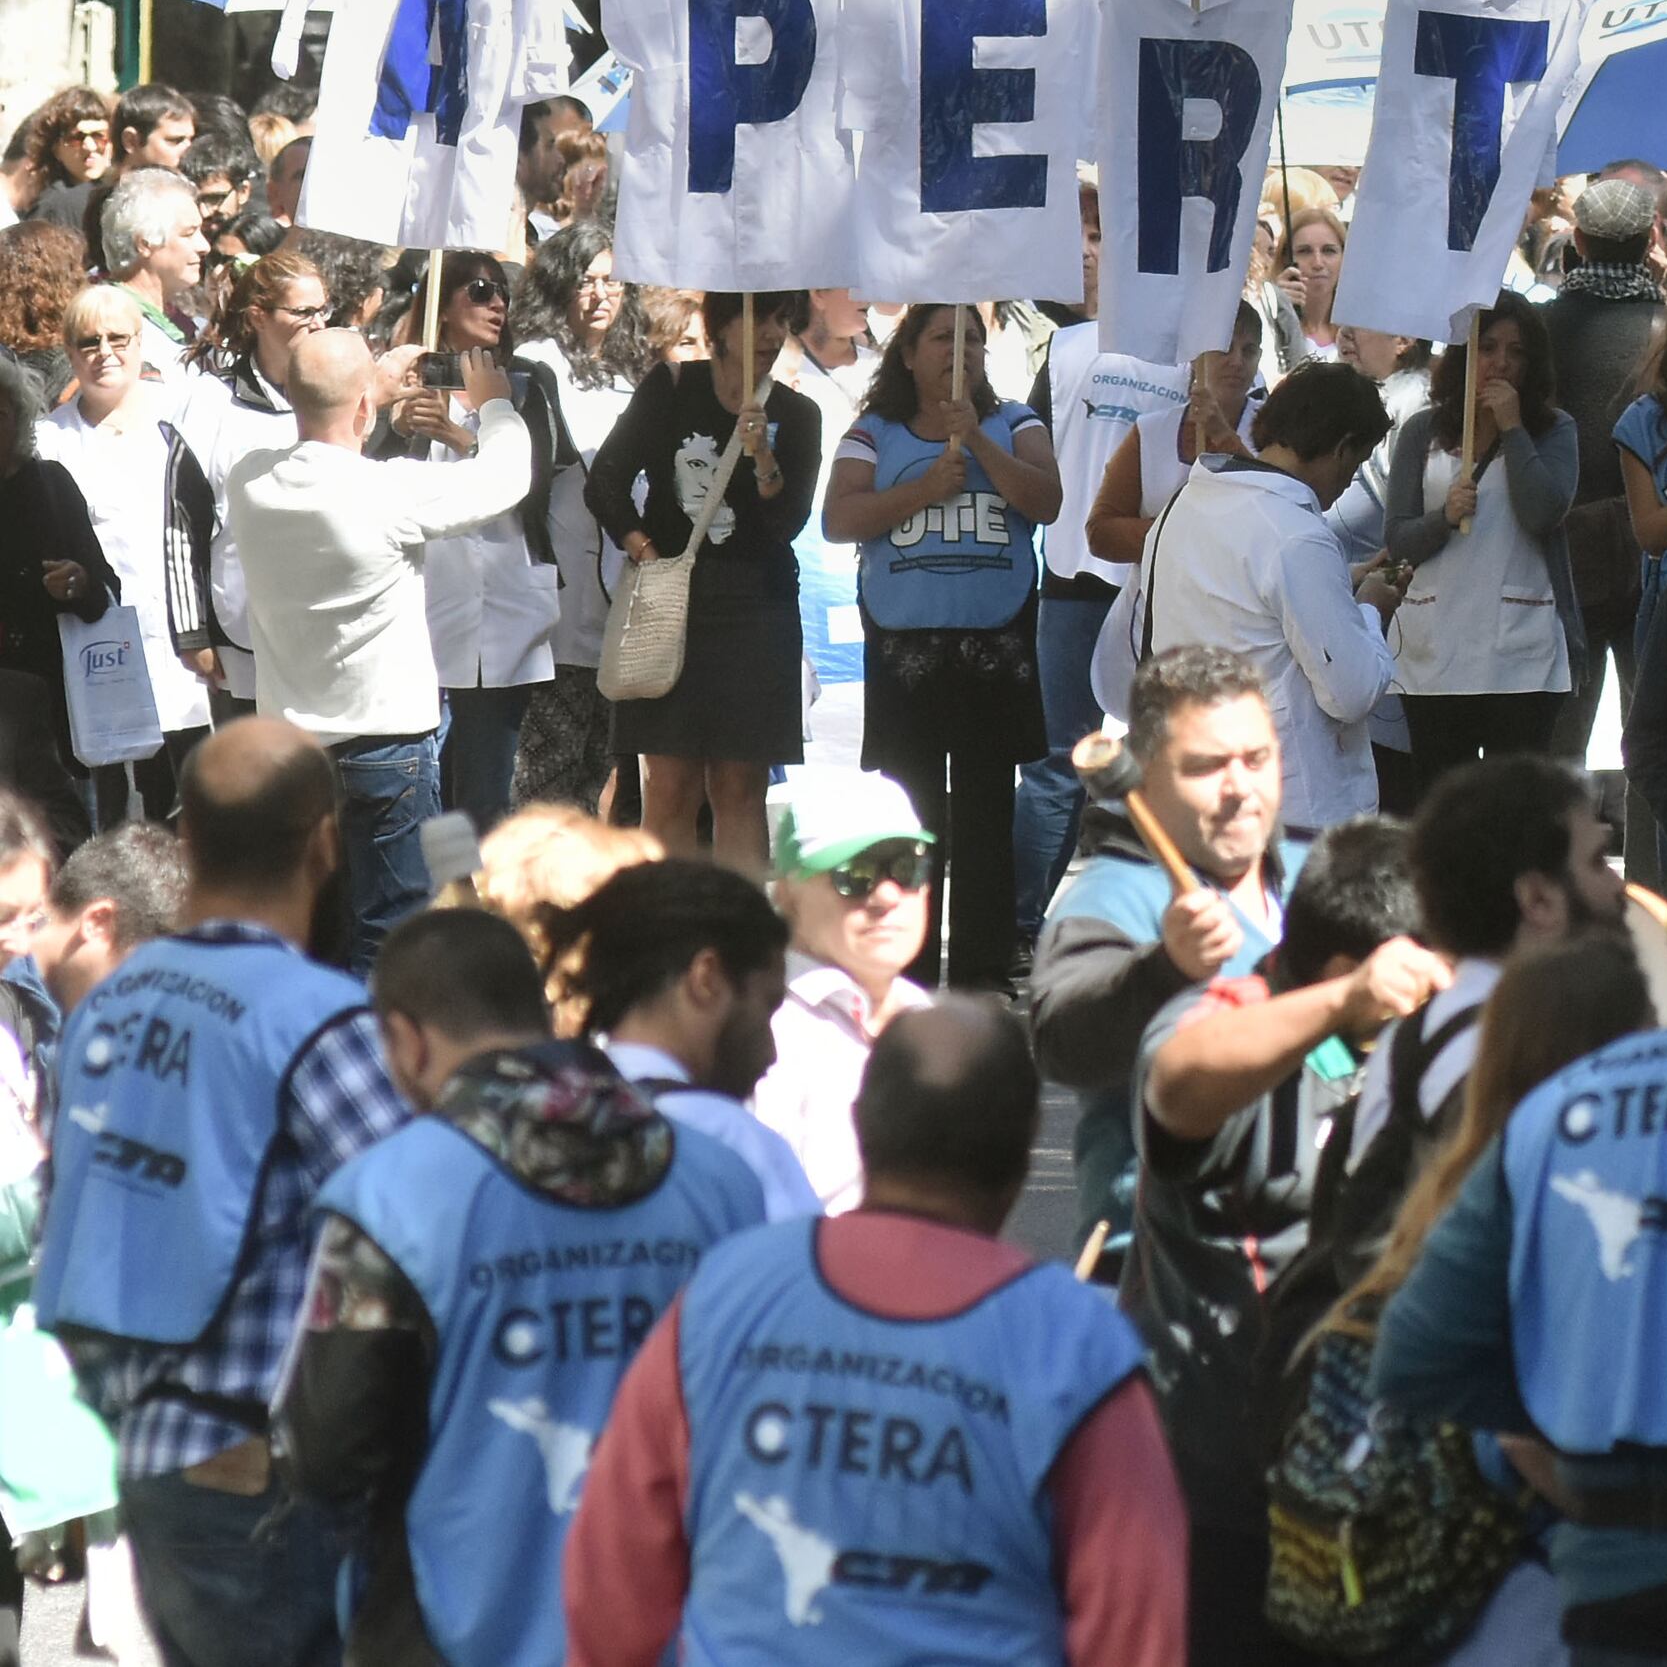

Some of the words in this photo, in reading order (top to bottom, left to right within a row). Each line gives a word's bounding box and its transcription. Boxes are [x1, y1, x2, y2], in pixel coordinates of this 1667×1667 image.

[1306, 18, 1384, 52] UT
[1092, 374, 1189, 404] ORGANIZACION
[744, 1401, 976, 1497] CTERA
